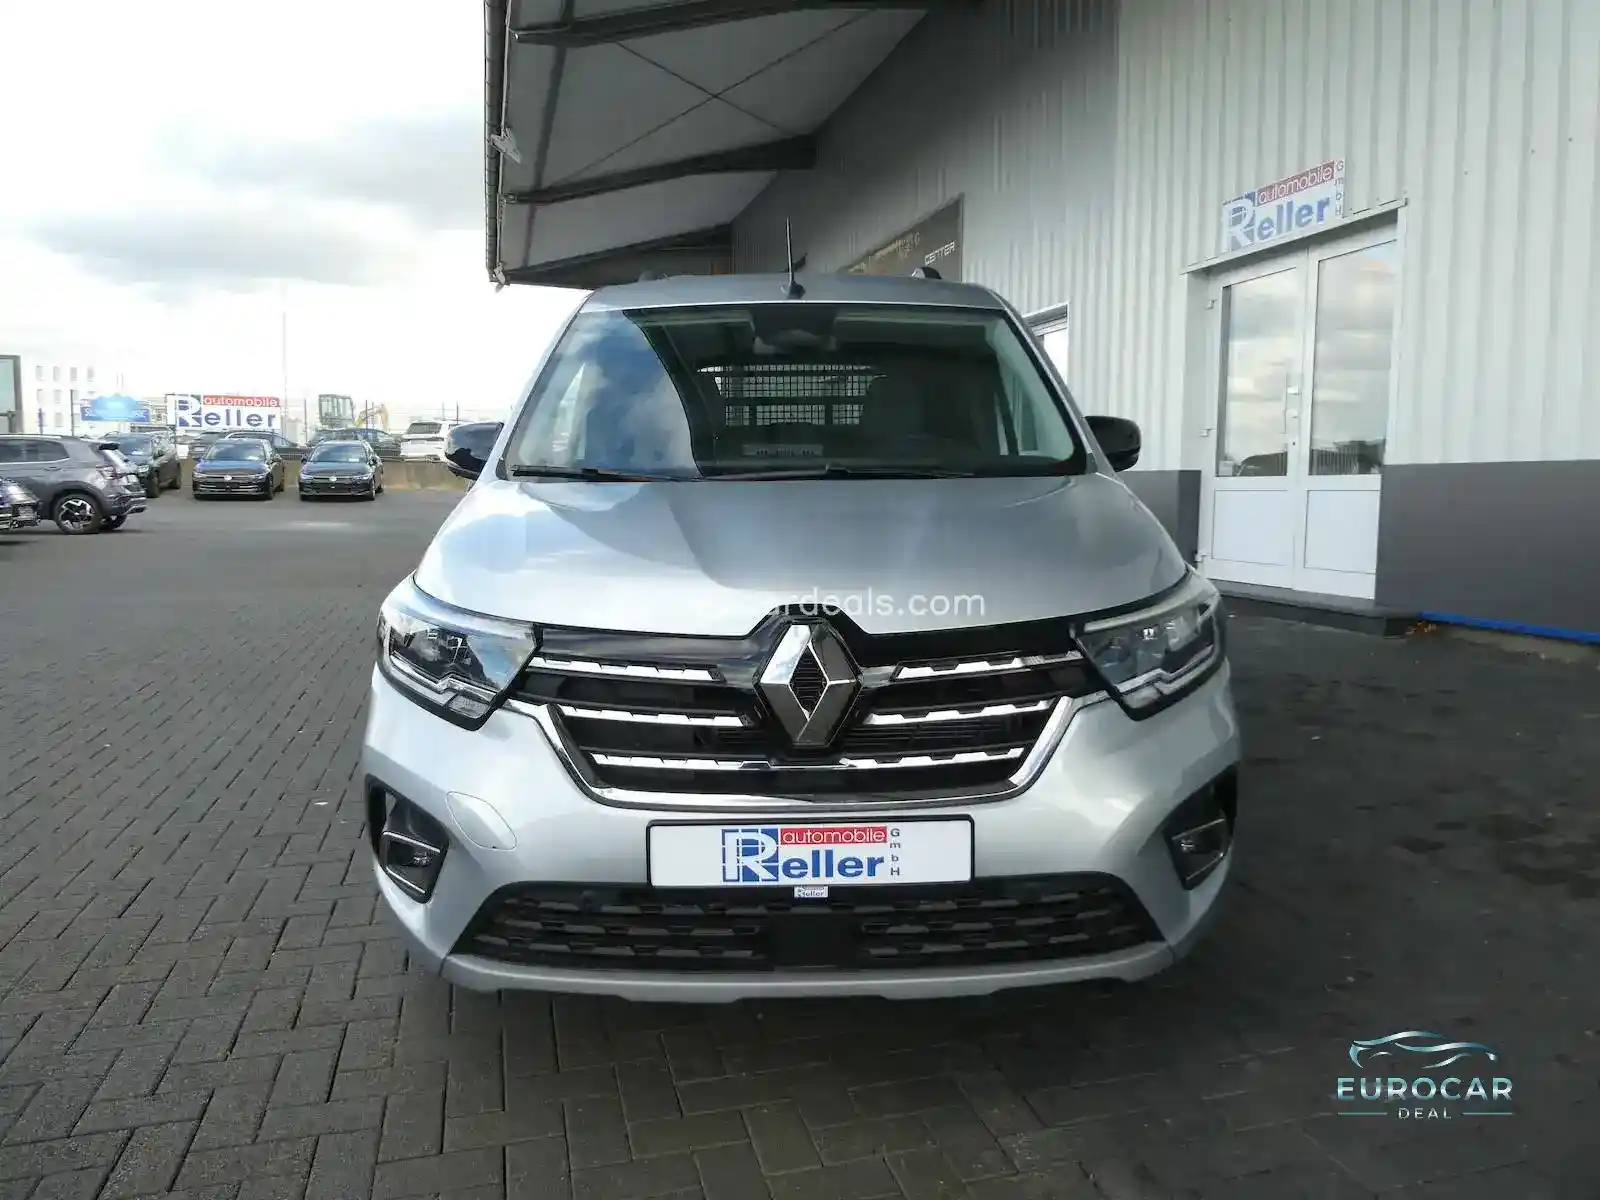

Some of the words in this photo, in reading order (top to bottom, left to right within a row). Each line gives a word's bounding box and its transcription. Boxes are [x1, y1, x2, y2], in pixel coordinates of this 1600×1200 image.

[1257, 164, 1333, 205] automobile
[1221, 192, 1331, 252] Reller
[165, 394, 277, 427] Reller
[203, 396, 279, 407] automobile
[782, 827, 887, 844] automobile
[721, 828, 884, 882] Reller
